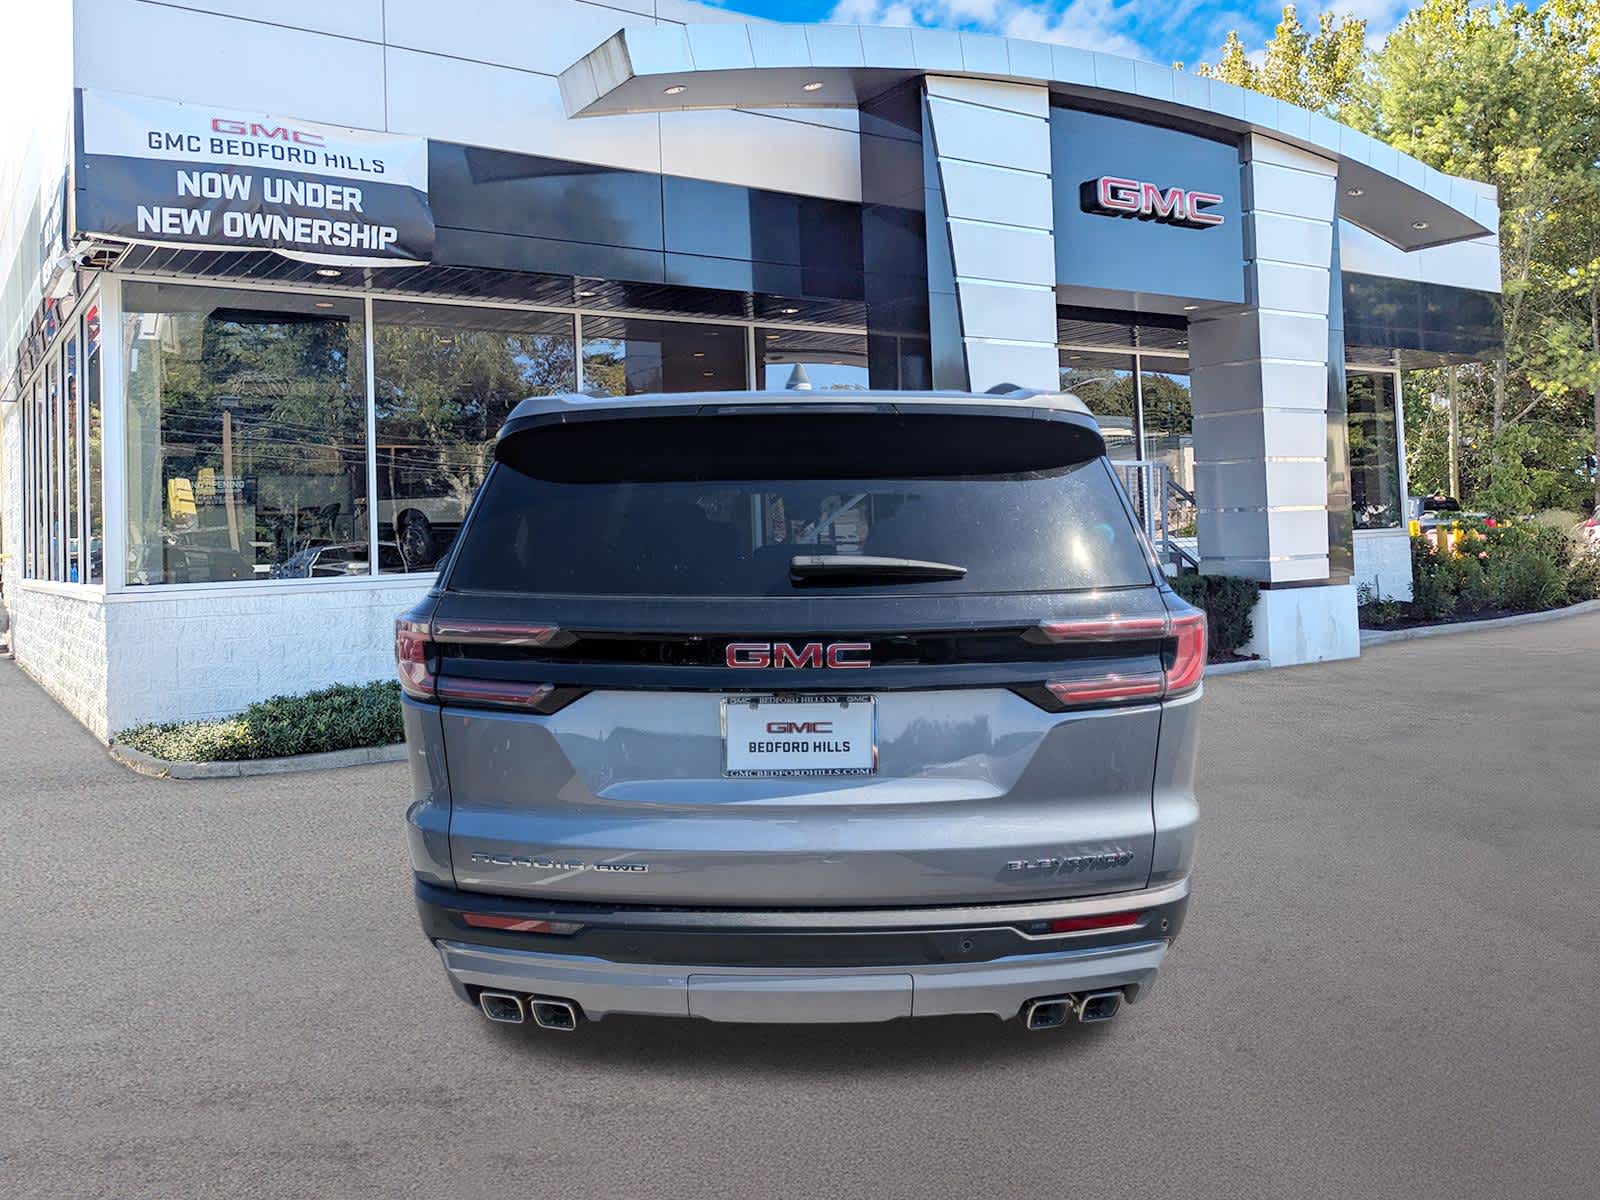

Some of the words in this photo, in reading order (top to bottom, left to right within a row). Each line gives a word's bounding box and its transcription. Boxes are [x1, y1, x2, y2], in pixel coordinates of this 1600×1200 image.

[211, 118, 325, 147] GMC
[147, 131, 201, 153] GMC
[209, 137, 317, 166] BEDFORD
[324, 154, 386, 174] HILLS
[176, 170, 252, 201] NOW
[263, 178, 363, 213] UNDER
[1098, 175, 1225, 225] GMC
[137, 205, 210, 236] NEW
[223, 211, 398, 250] OWNERSHIP
[726, 642, 871, 669] GMC
[766, 721, 833, 734] GMC
[749, 741, 809, 753] BEDFORD
[813, 741, 851, 752] HILLS
[730, 767, 870, 777] GMCBEDFORDHILLS.COM
